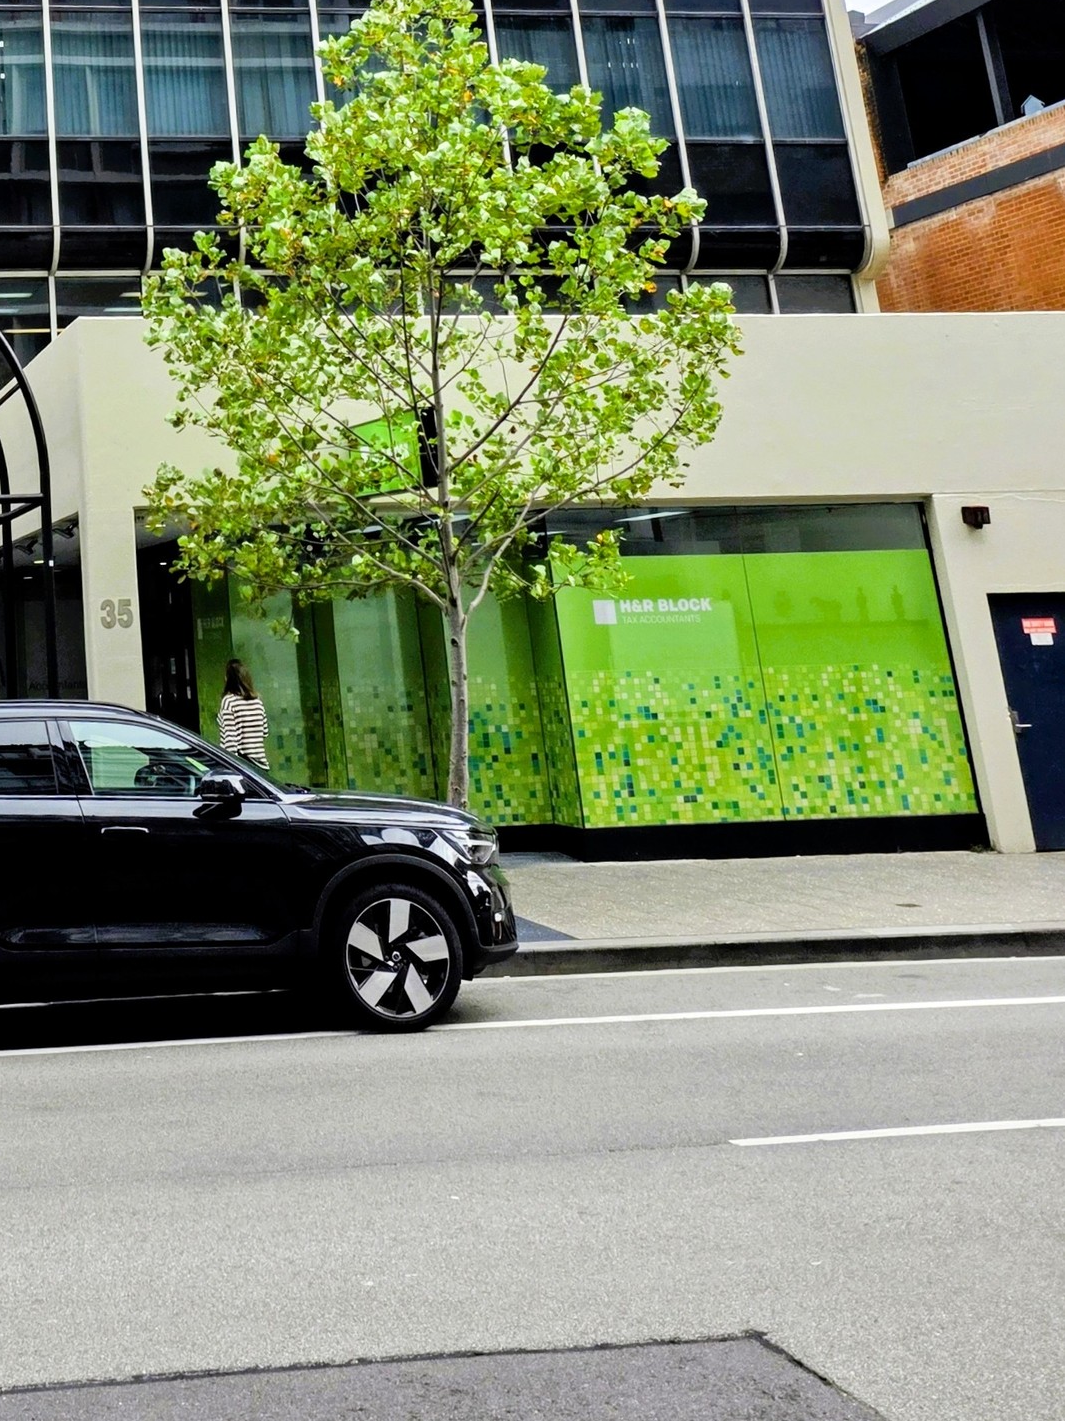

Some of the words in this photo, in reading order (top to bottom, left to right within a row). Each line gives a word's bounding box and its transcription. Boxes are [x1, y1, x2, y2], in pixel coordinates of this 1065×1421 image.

[619, 599, 654, 613] H&R
[657, 598, 712, 612] BLOCK
[100, 598, 134, 629] 35
[622, 616, 637, 624] TAX
[639, 614, 701, 624] ACCOUNTANTS
